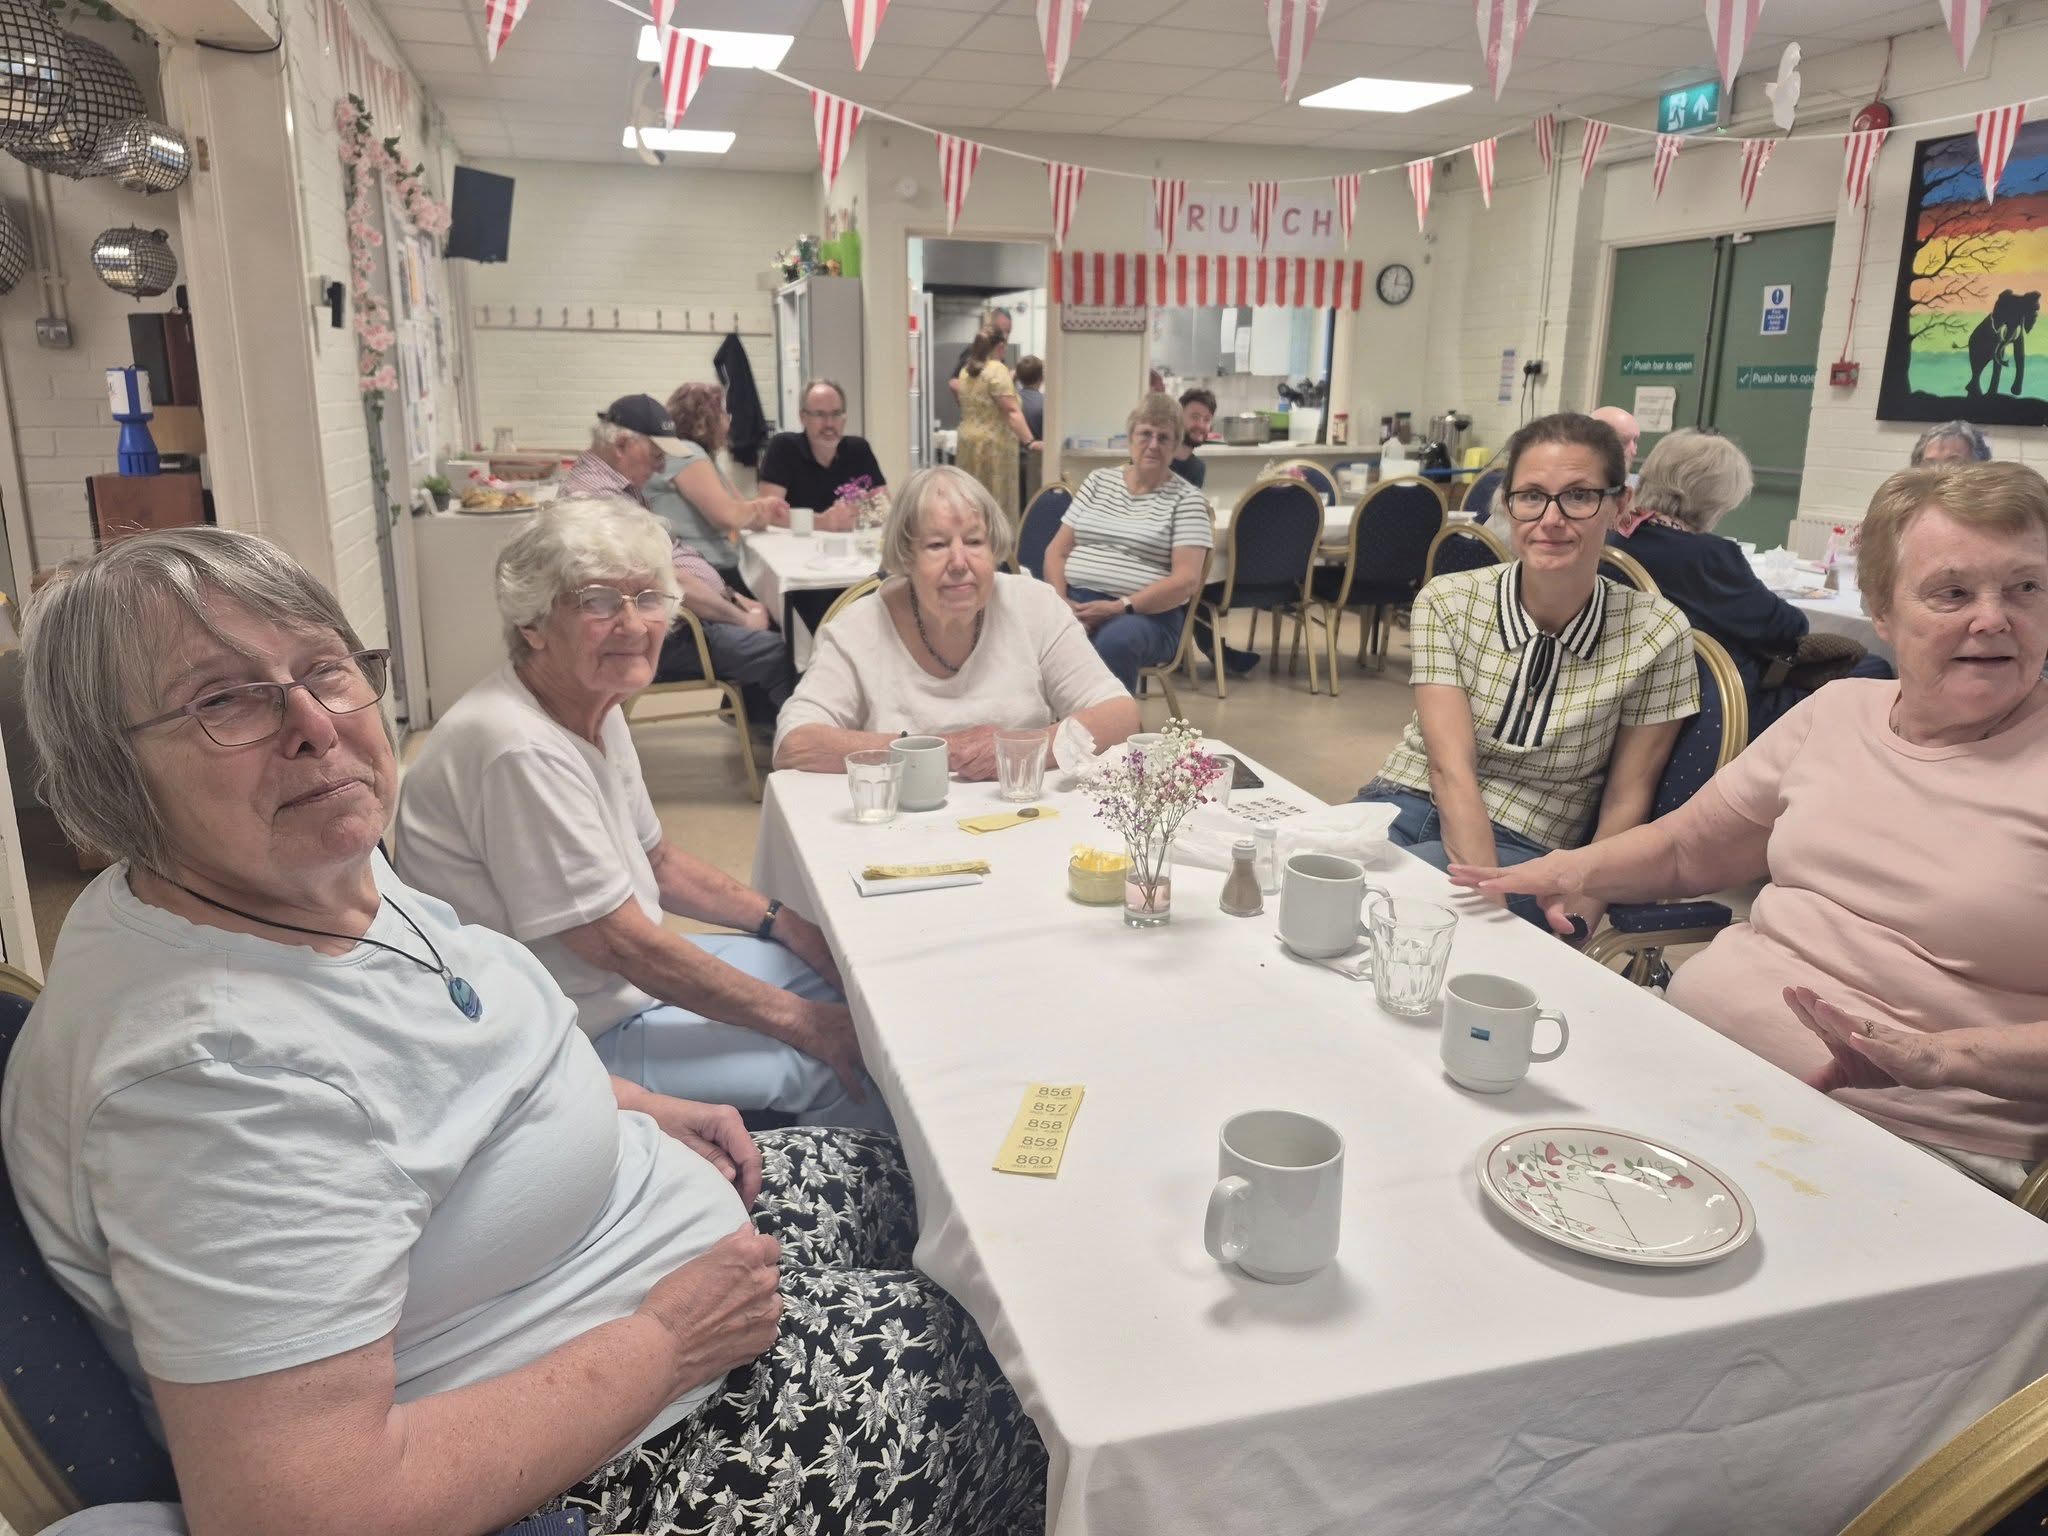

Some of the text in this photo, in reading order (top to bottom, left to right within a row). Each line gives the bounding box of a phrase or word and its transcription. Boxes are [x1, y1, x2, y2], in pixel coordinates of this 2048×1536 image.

[1154, 203, 1333, 237] RUCH
[1634, 360, 1693, 372] Push bar to open
[1752, 372, 1773, 383] Push
[1774, 373, 1788, 384] bar
[1789, 373, 1798, 384] to
[1038, 1086, 1072, 1097] 856
[1033, 1101, 1068, 1113] 857
[1027, 1118, 1063, 1130] 858
[1022, 1135, 1058, 1147] 859
[1015, 1154, 1053, 1165] 860
